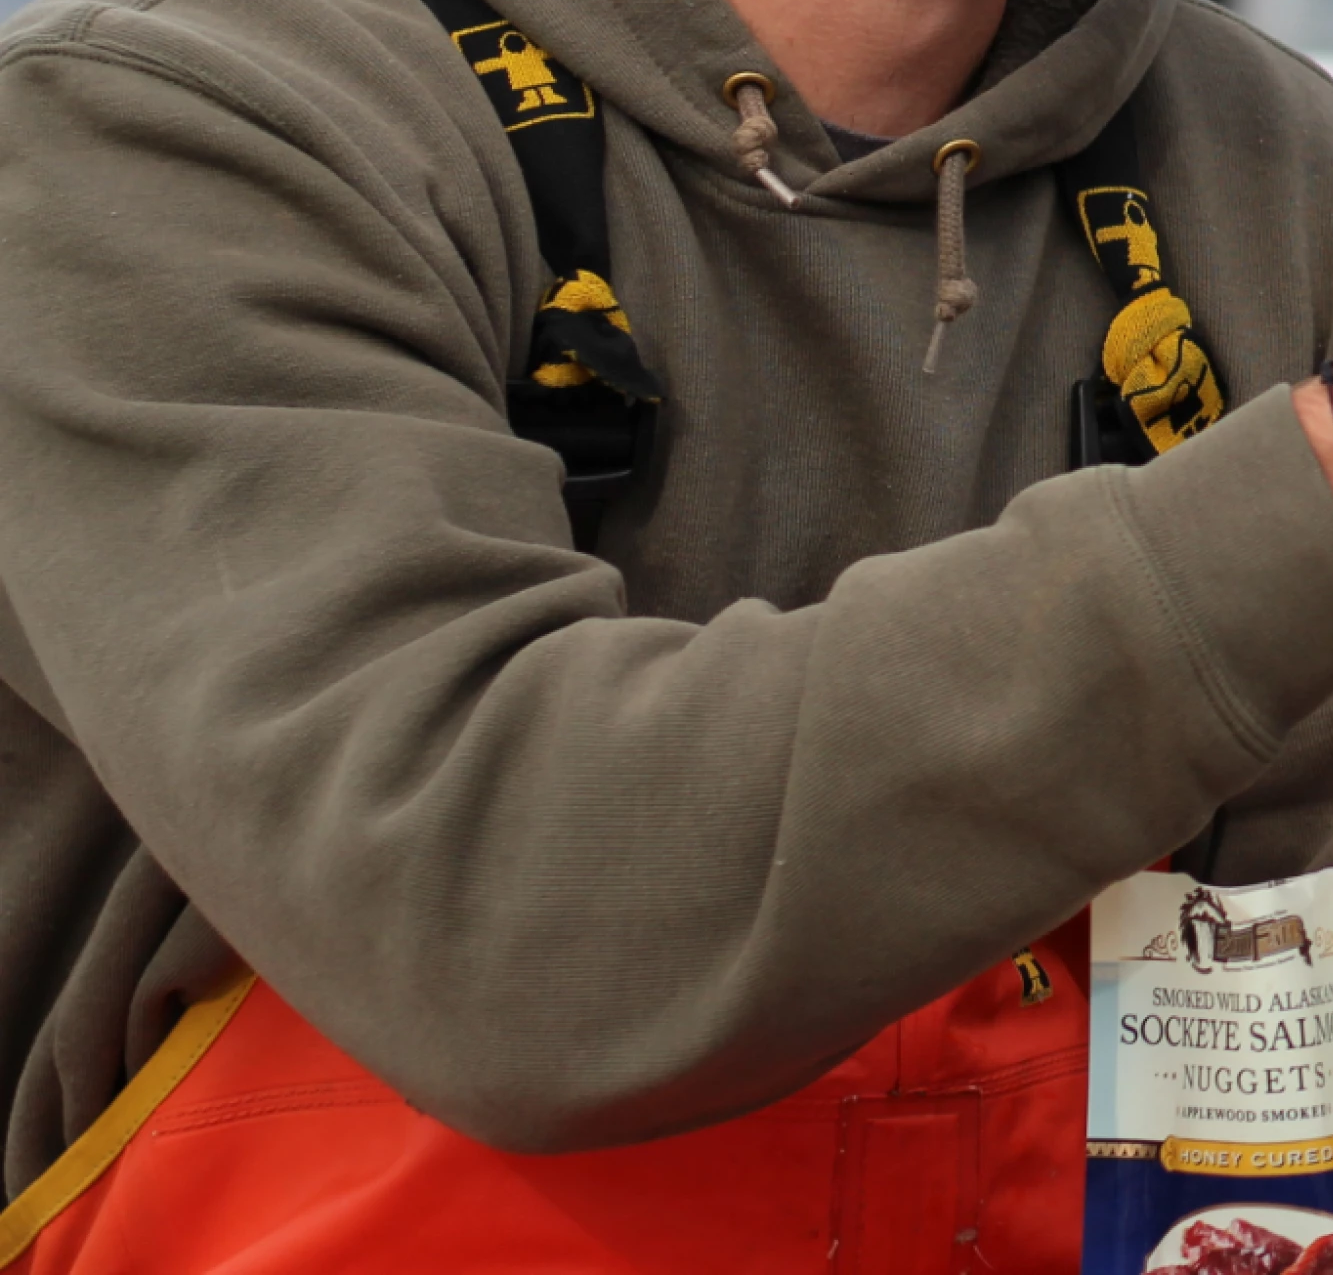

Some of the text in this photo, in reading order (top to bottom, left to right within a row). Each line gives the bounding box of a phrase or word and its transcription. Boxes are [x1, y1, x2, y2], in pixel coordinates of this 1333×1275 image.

[1152, 987, 1214, 1010] SMOKED
[1216, 991, 1262, 1013] WILD
[1120, 1012, 1241, 1052] SOCKEYE
[1182, 1062, 1326, 1095] NUGGETS
[1182, 1103, 1328, 1123] APPLEWOOD SMOKED
[1179, 1148, 1243, 1168] HONEY
